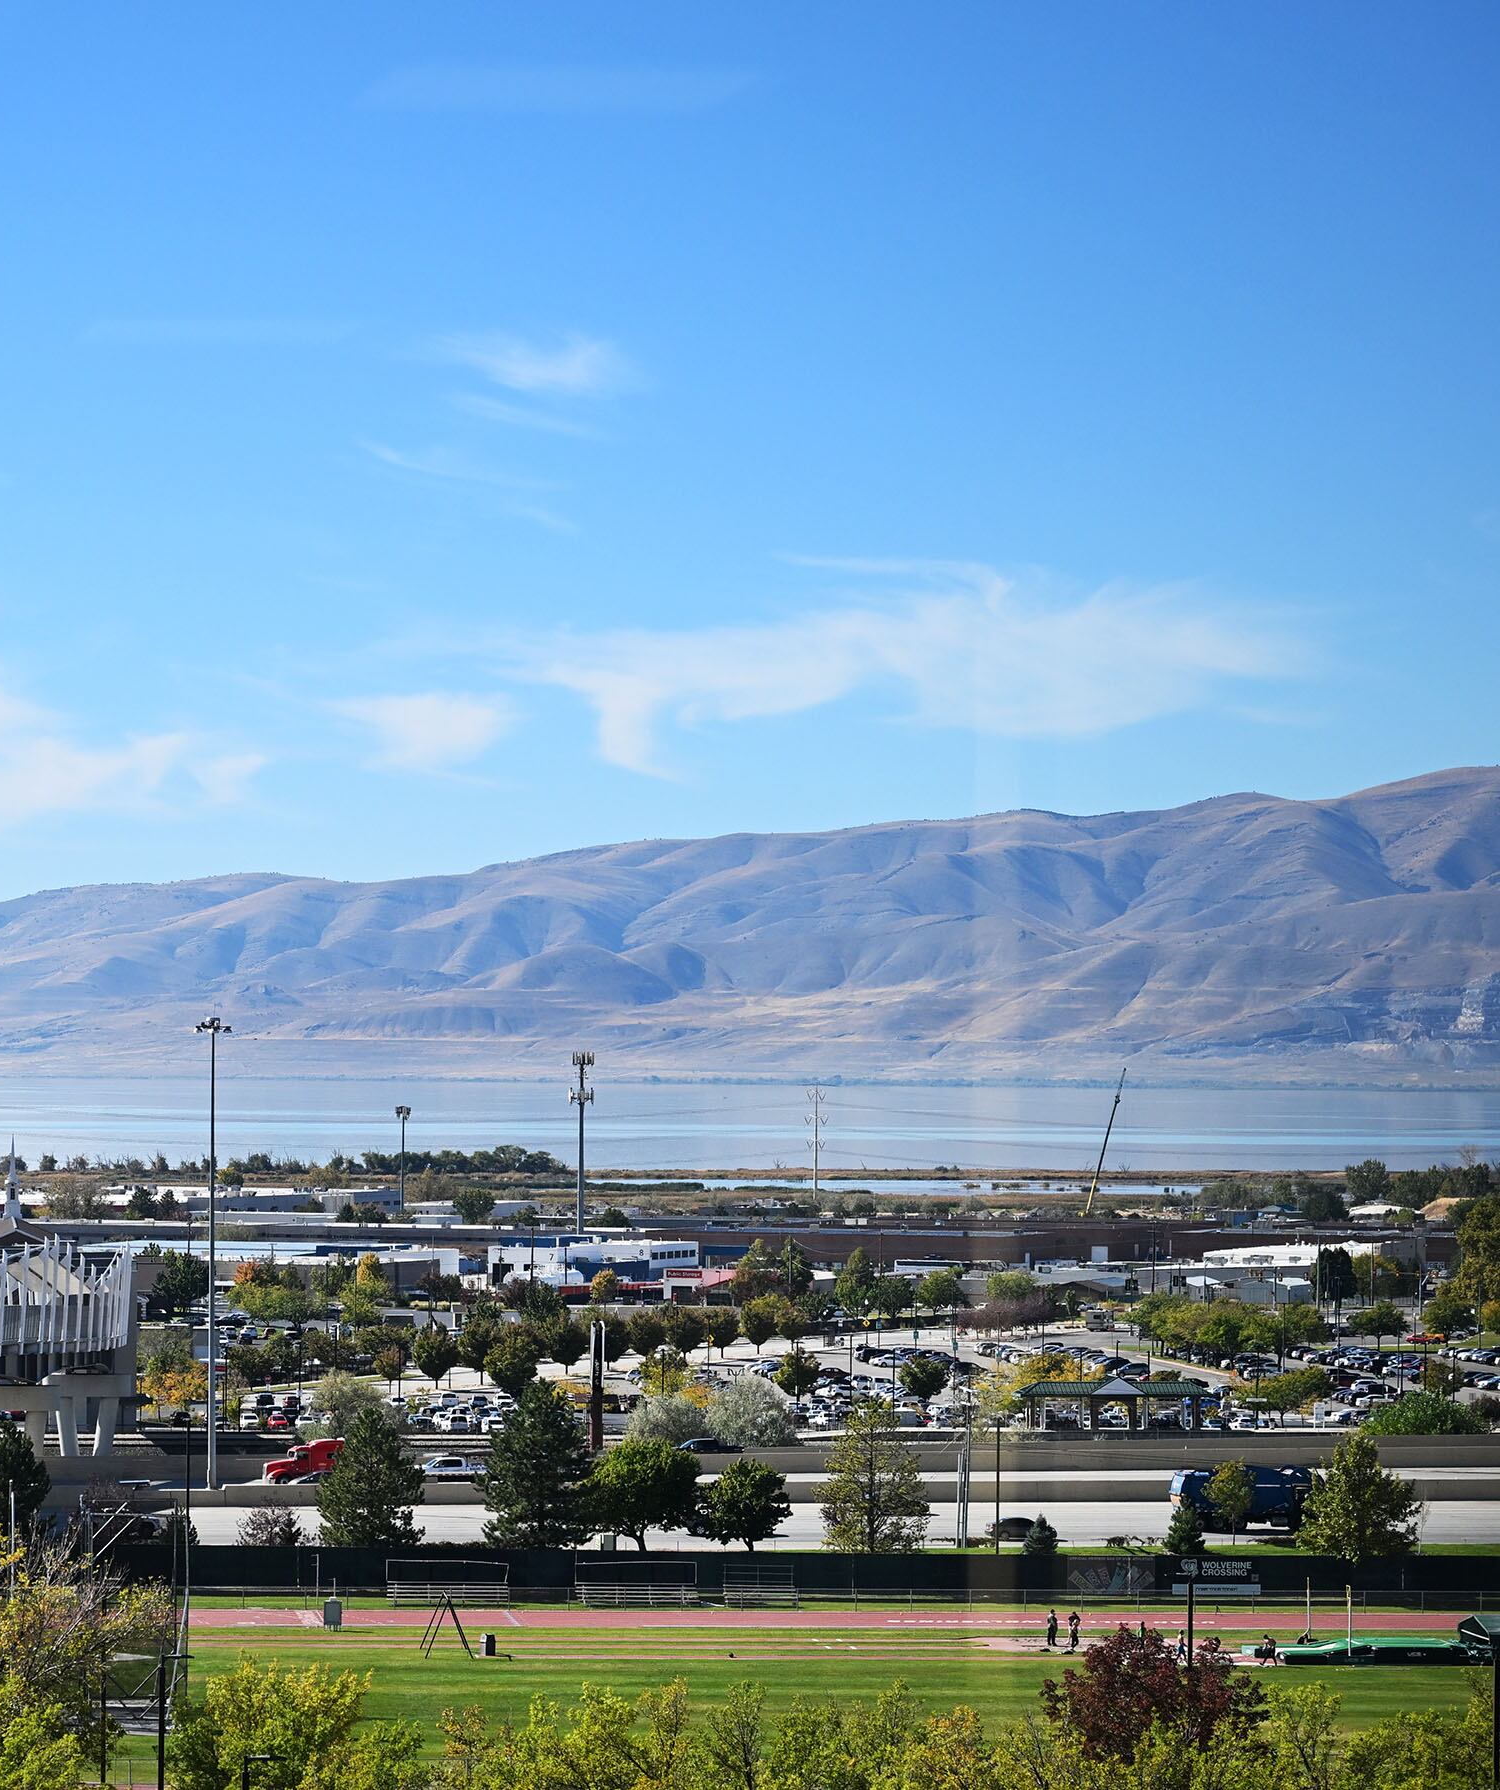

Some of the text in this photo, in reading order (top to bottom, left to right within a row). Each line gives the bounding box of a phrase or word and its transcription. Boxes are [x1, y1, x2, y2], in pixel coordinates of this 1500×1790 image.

[639, 1248, 644, 1256] 8
[549, 1253, 554, 1261] 7
[1202, 1561, 1252, 1569] WOLVERINE
[1202, 1569, 1248, 1577] CROSSING
